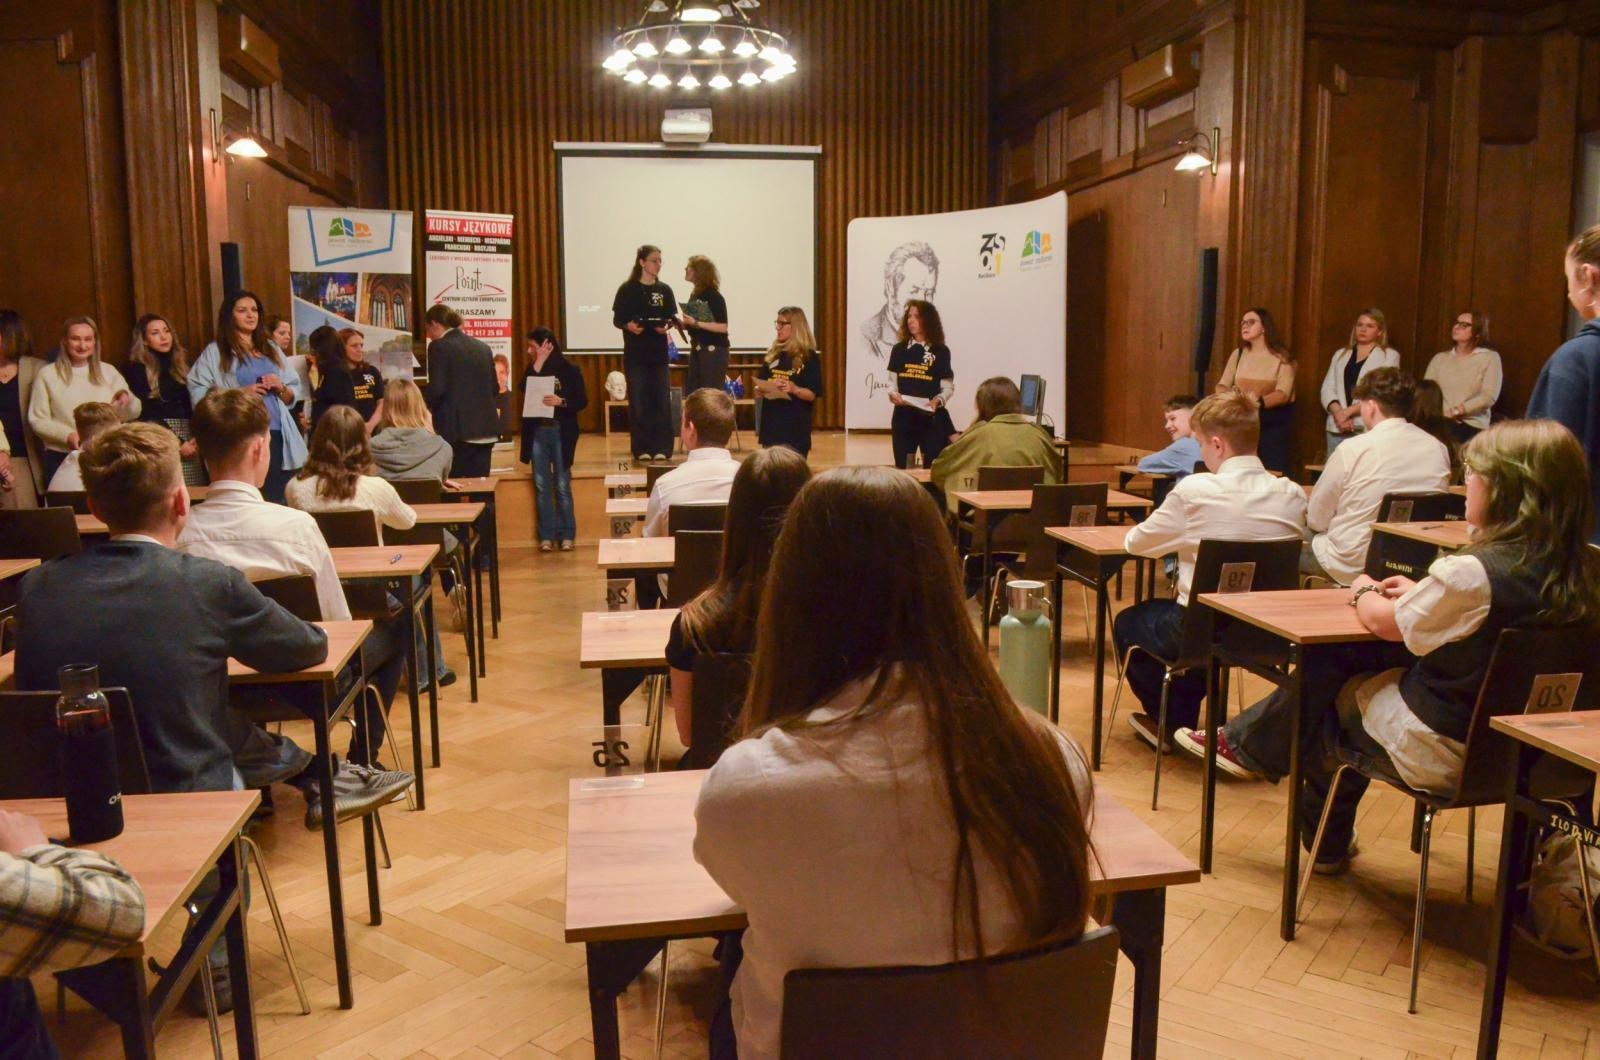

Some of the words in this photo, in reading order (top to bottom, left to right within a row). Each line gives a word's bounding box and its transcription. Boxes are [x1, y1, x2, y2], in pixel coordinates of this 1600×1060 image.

[429, 218, 461, 232] KURSY
[463, 221, 512, 235] JĘZYKOWE
[455, 308, 496, 316] PRASZAMY
